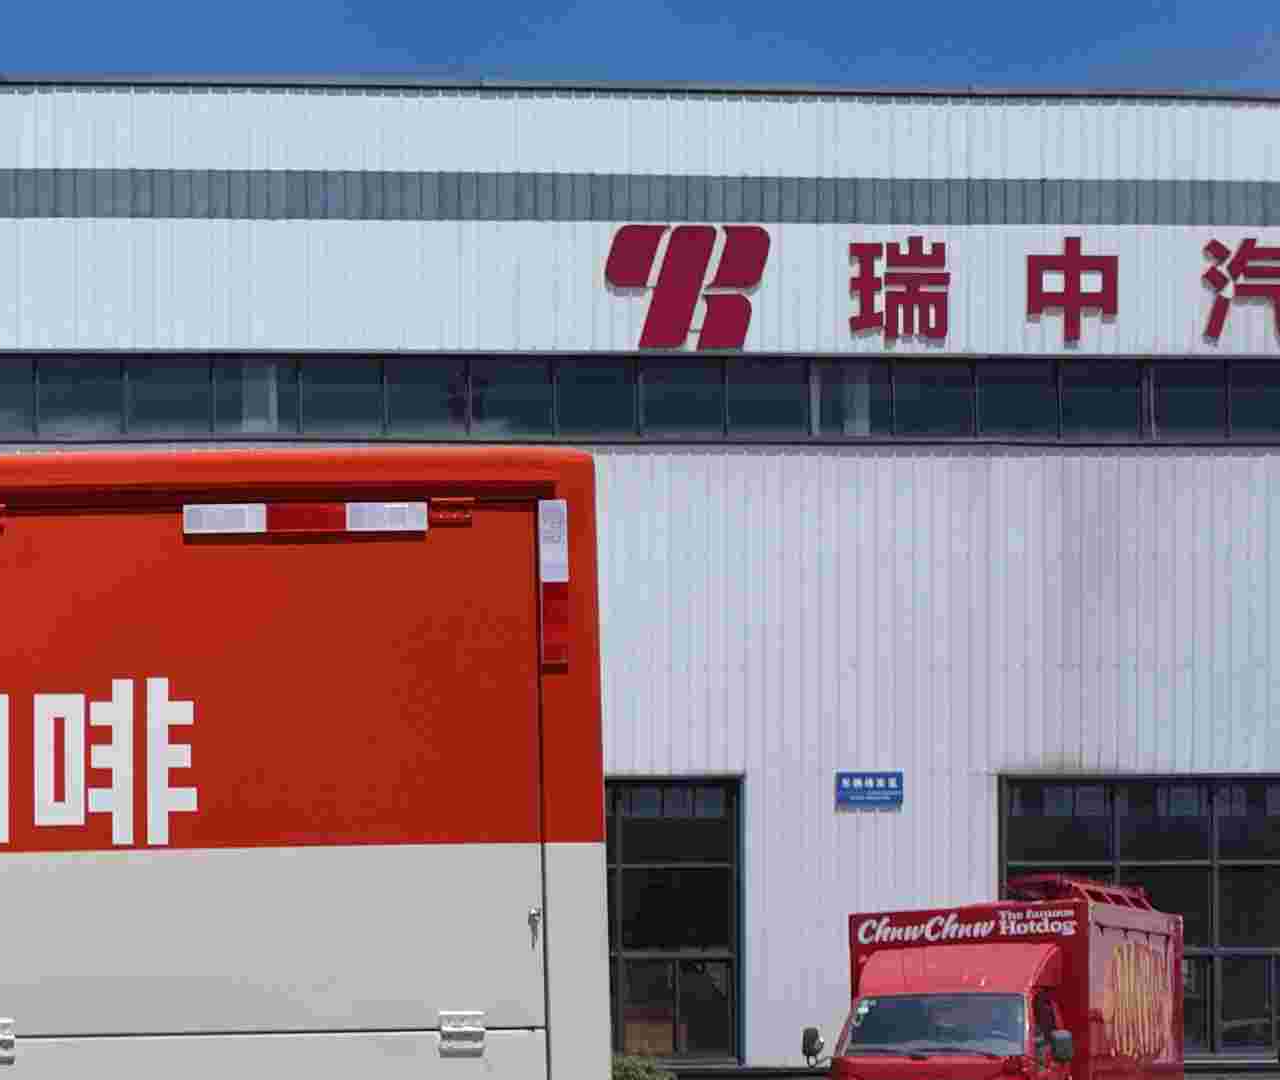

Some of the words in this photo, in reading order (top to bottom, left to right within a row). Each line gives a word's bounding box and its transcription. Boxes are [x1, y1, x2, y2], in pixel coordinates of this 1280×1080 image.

[849, 235, 1280, 345] 瑞中汽
[998, 916, 1077, 936] Hotdog
